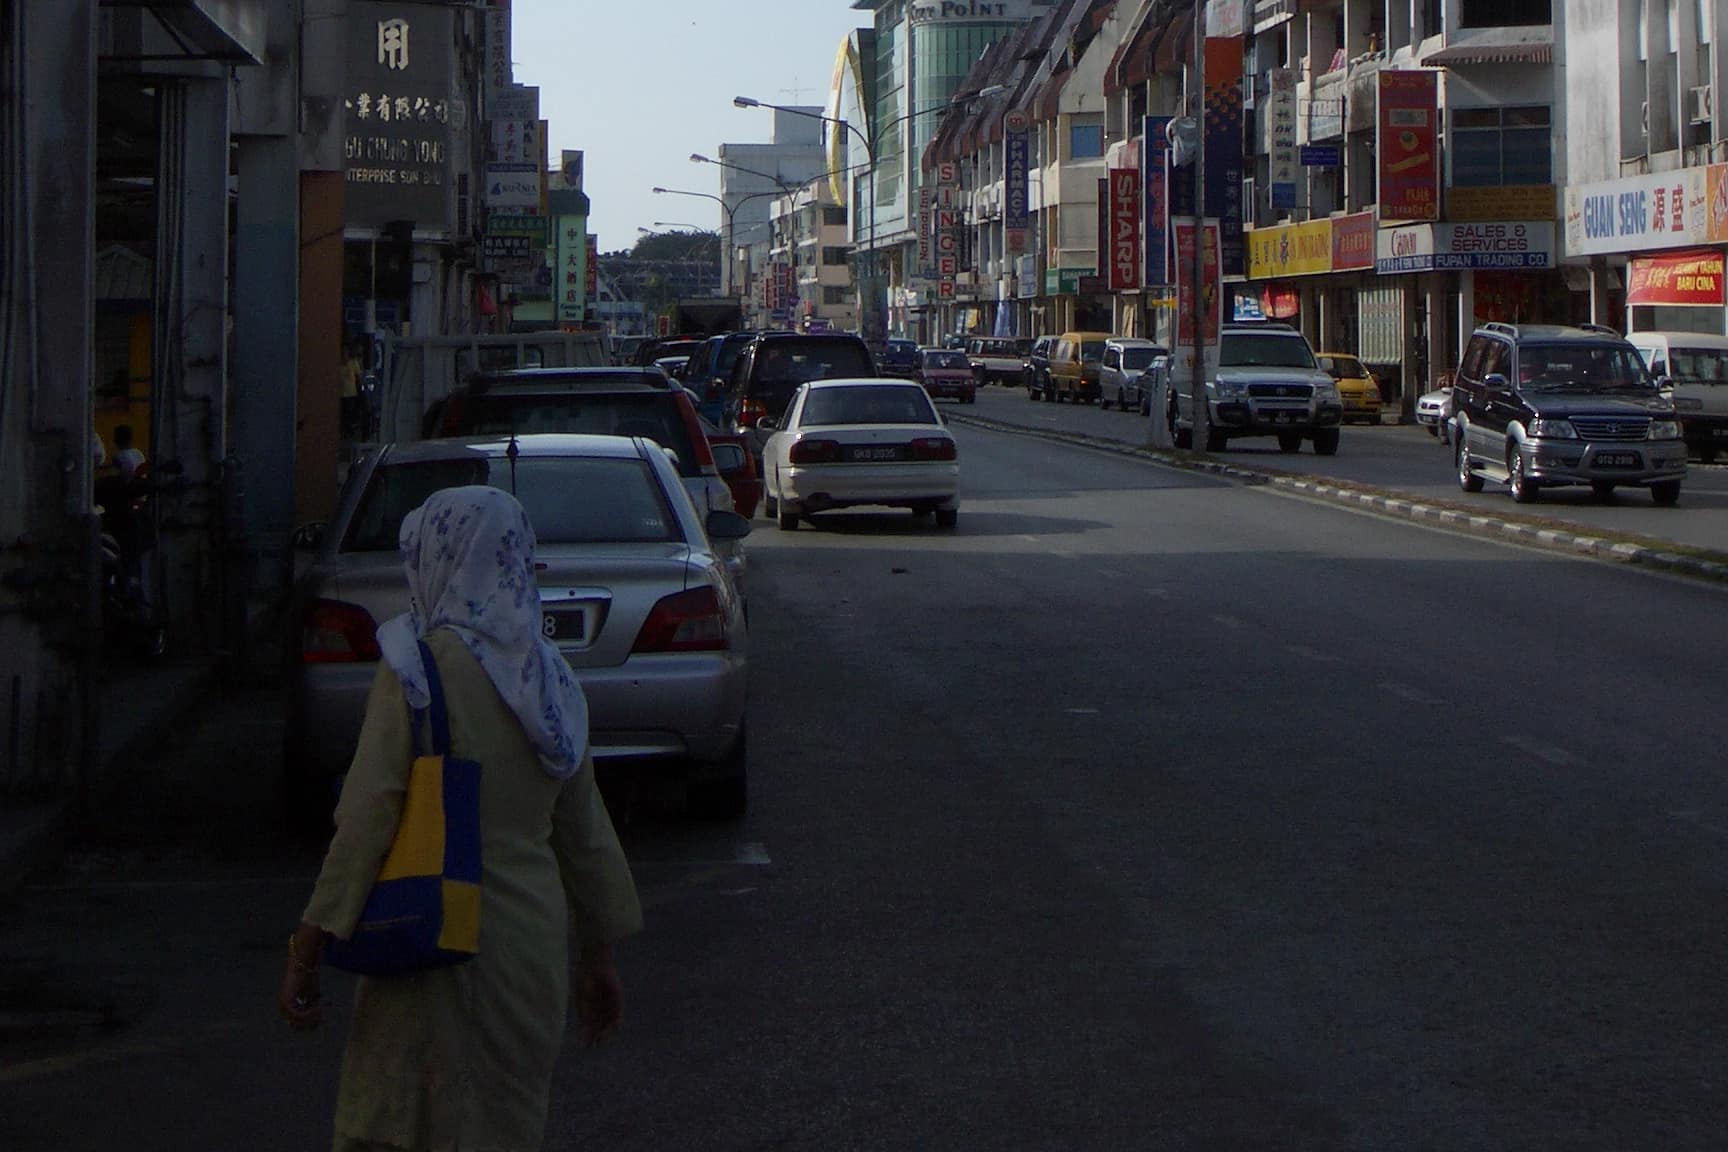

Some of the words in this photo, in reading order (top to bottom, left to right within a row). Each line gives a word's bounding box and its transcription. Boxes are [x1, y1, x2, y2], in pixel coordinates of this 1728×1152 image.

[345, 91, 449, 124] 業有限公司
[919, 189, 928, 208] Inn
[1010, 141, 1024, 218] PHARMACY
[940, 166, 954, 297] SINGER
[1116, 175, 1133, 284] SHARP
[1454, 224, 1505, 238] SALES
[1583, 194, 1615, 239] GUAN
[1619, 190, 1647, 237] SENG
[919, 212, 928, 261] National
[1452, 238, 1528, 252] SERVICES
[1436, 254, 1472, 267] FUPAN
[1477, 253, 1524, 266] TRADING
[1528, 252, 1546, 265] CO.
